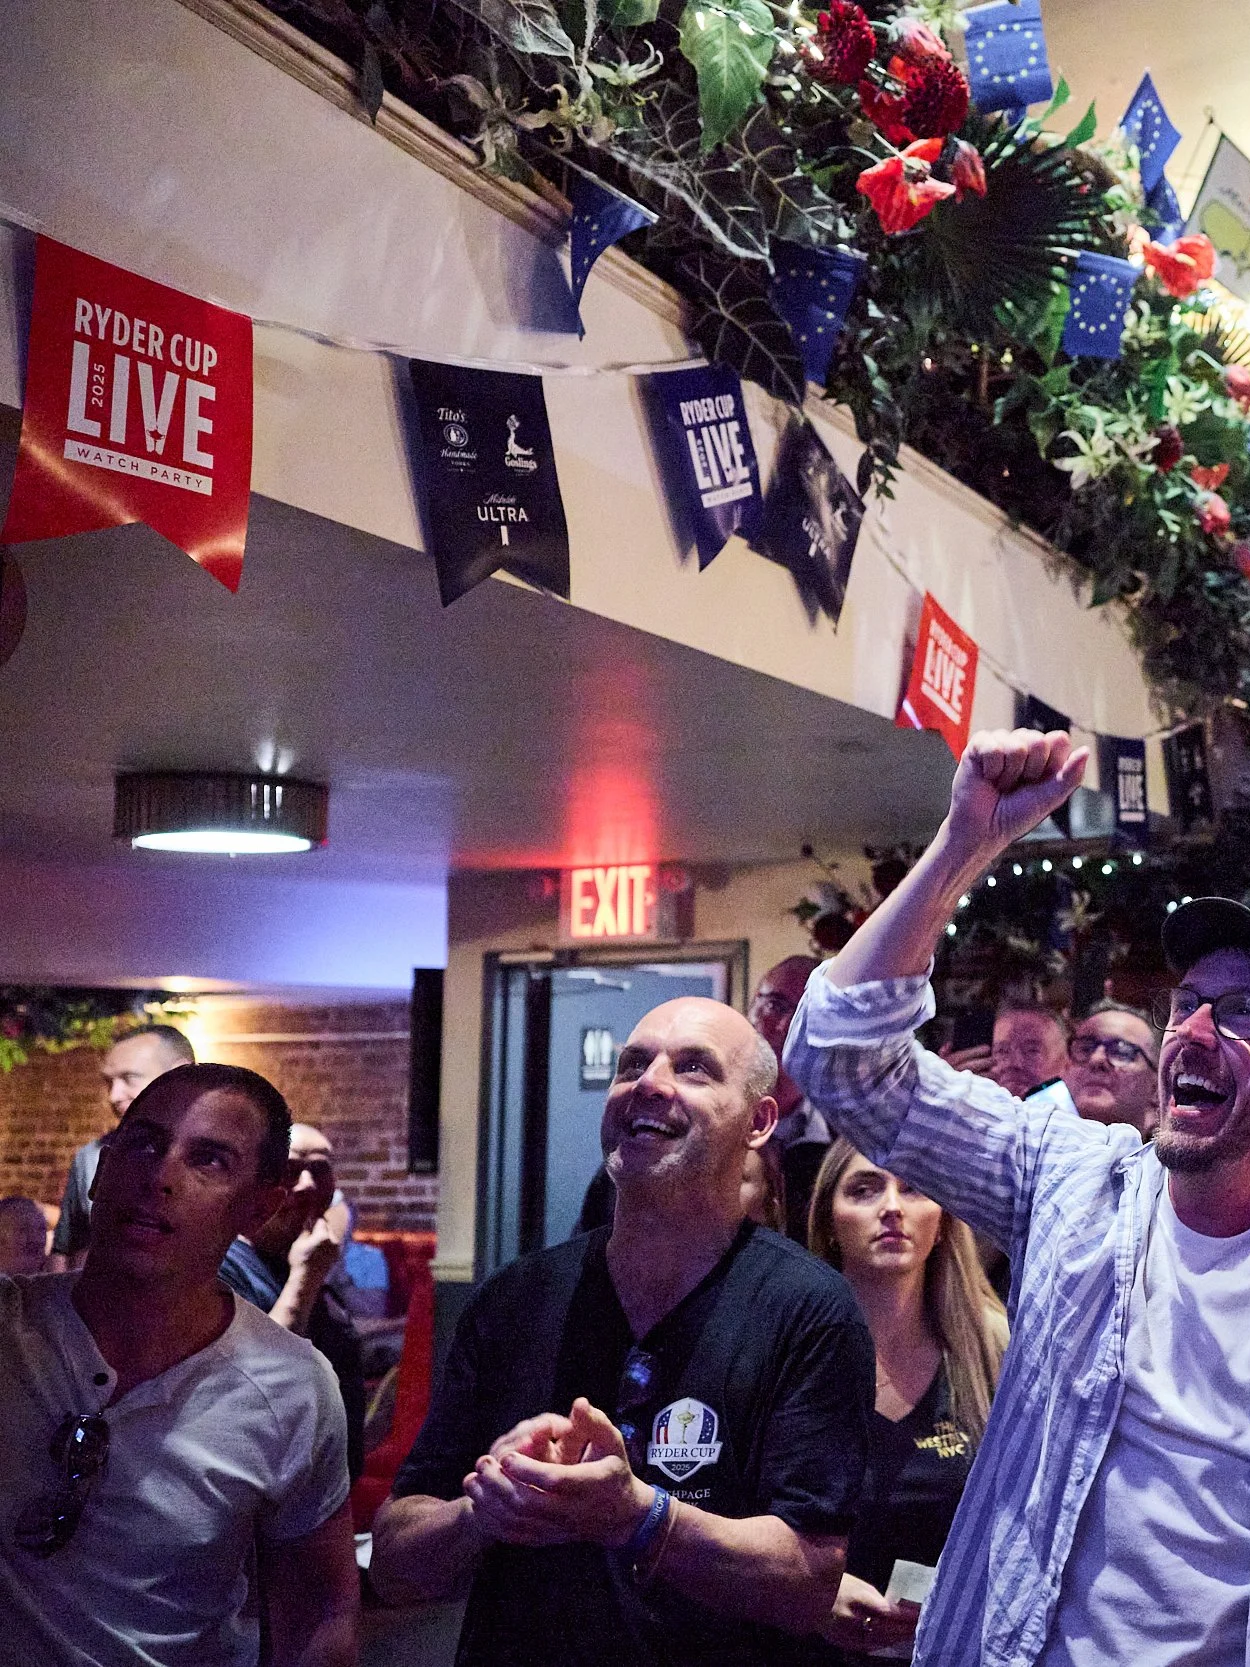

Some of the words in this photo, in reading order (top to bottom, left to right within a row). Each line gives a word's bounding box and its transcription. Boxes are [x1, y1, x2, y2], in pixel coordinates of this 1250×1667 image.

[75, 297, 164, 361] RYDER
[170, 333, 217, 376] CUP
[67, 340, 216, 469] LIVE
[92, 363, 106, 407] 2025
[437, 407, 465, 423] Tito's
[680, 398, 718, 425] RYDER
[715, 394, 735, 419] CUP
[77, 447, 139, 471] WATCH
[150, 466, 203, 488] PARTY
[686, 421, 750, 490] LIVE
[477, 505, 529, 521] ULTRA
[923, 637, 966, 712] LIVE
[570, 865, 651, 937] EXIT
[651, 1447, 688, 1458] RYDER
[690, 1447, 716, 1458] CUP
[671, 1463, 690, 1471] 2025
[937, 1443, 965, 1458] NYC
